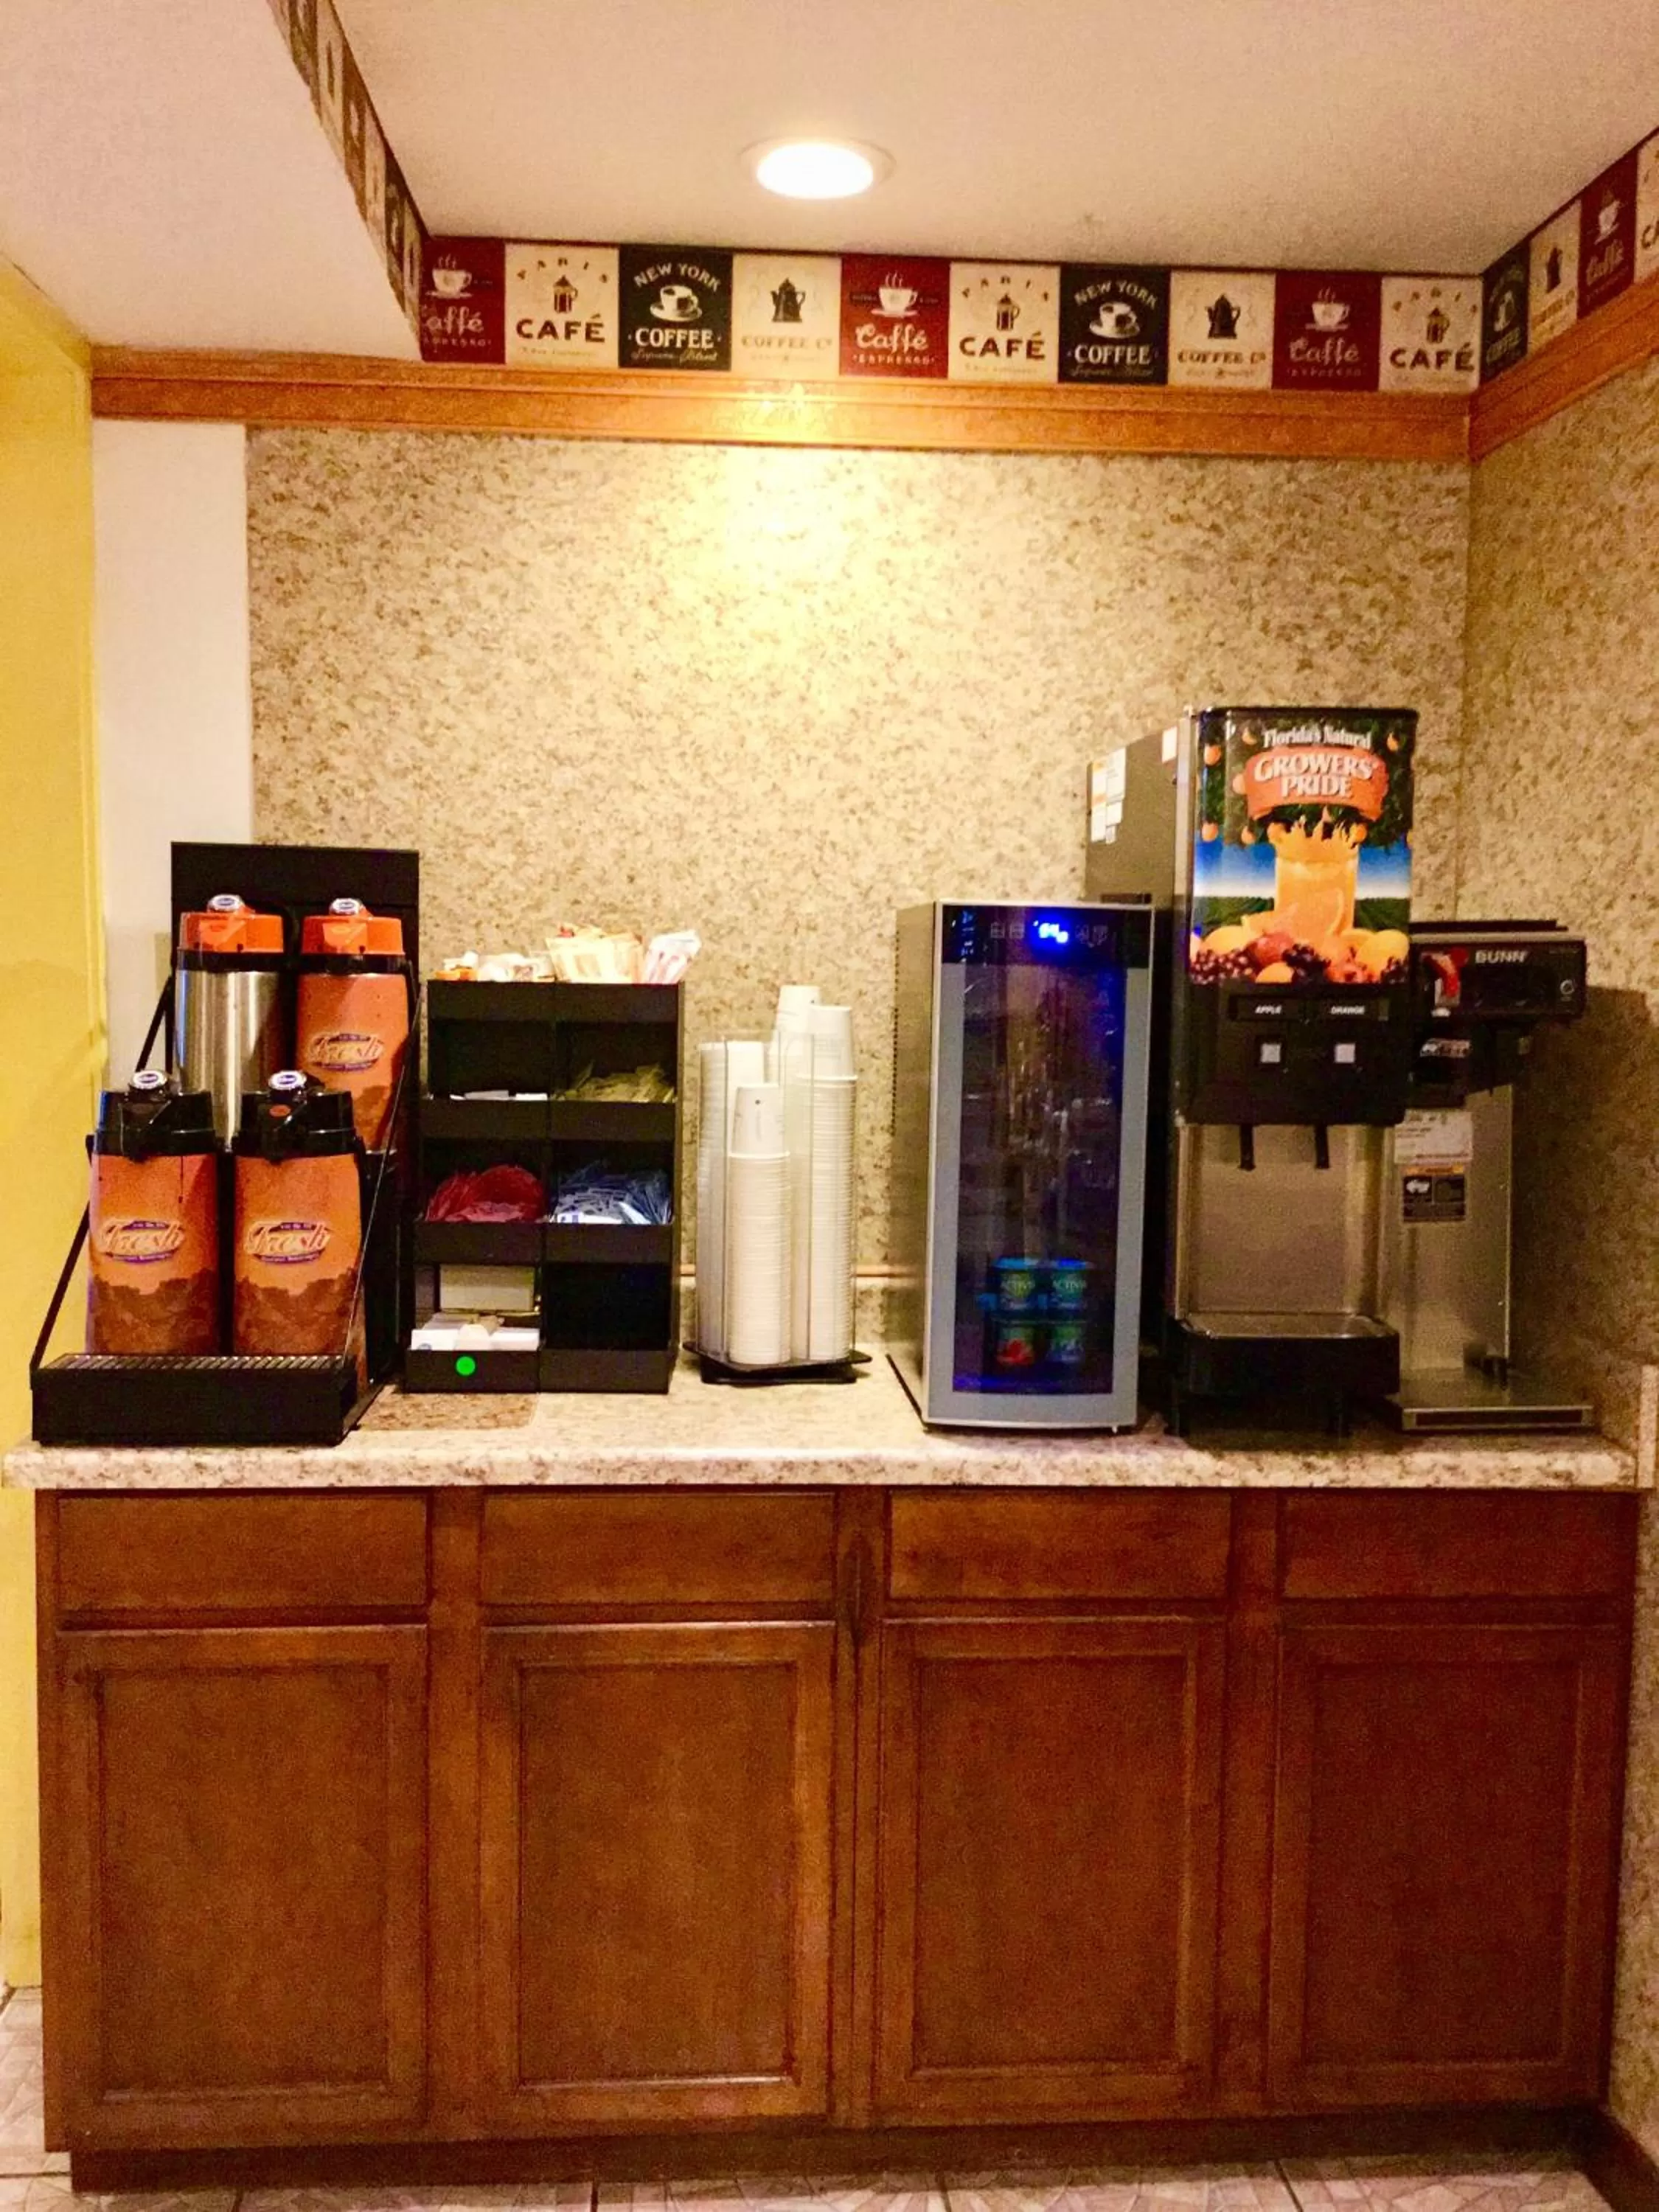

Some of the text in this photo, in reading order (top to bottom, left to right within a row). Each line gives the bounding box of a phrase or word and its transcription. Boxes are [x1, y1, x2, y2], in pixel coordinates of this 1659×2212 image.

[634, 262, 721, 292] NEW YORK
[1074, 279, 1158, 309] NEW YORK
[516, 313, 605, 343] CAFÉ
[635, 327, 714, 349] COFFEE
[855, 323, 928, 354] Caffé
[959, 330, 1046, 360] CAFÉ
[1074, 344, 1152, 365] COFFEE
[1178, 350, 1244, 364] COFFEE
[1389, 342, 1475, 372] CAFÉ
[1263, 722, 1371, 750] Florida's Natural
[1281, 774, 1352, 799] PRIDE
[1475, 949, 1530, 964] BUNN
[1255, 1004, 1282, 1015] APPLE
[1330, 1005, 1366, 1015] ORANGE
